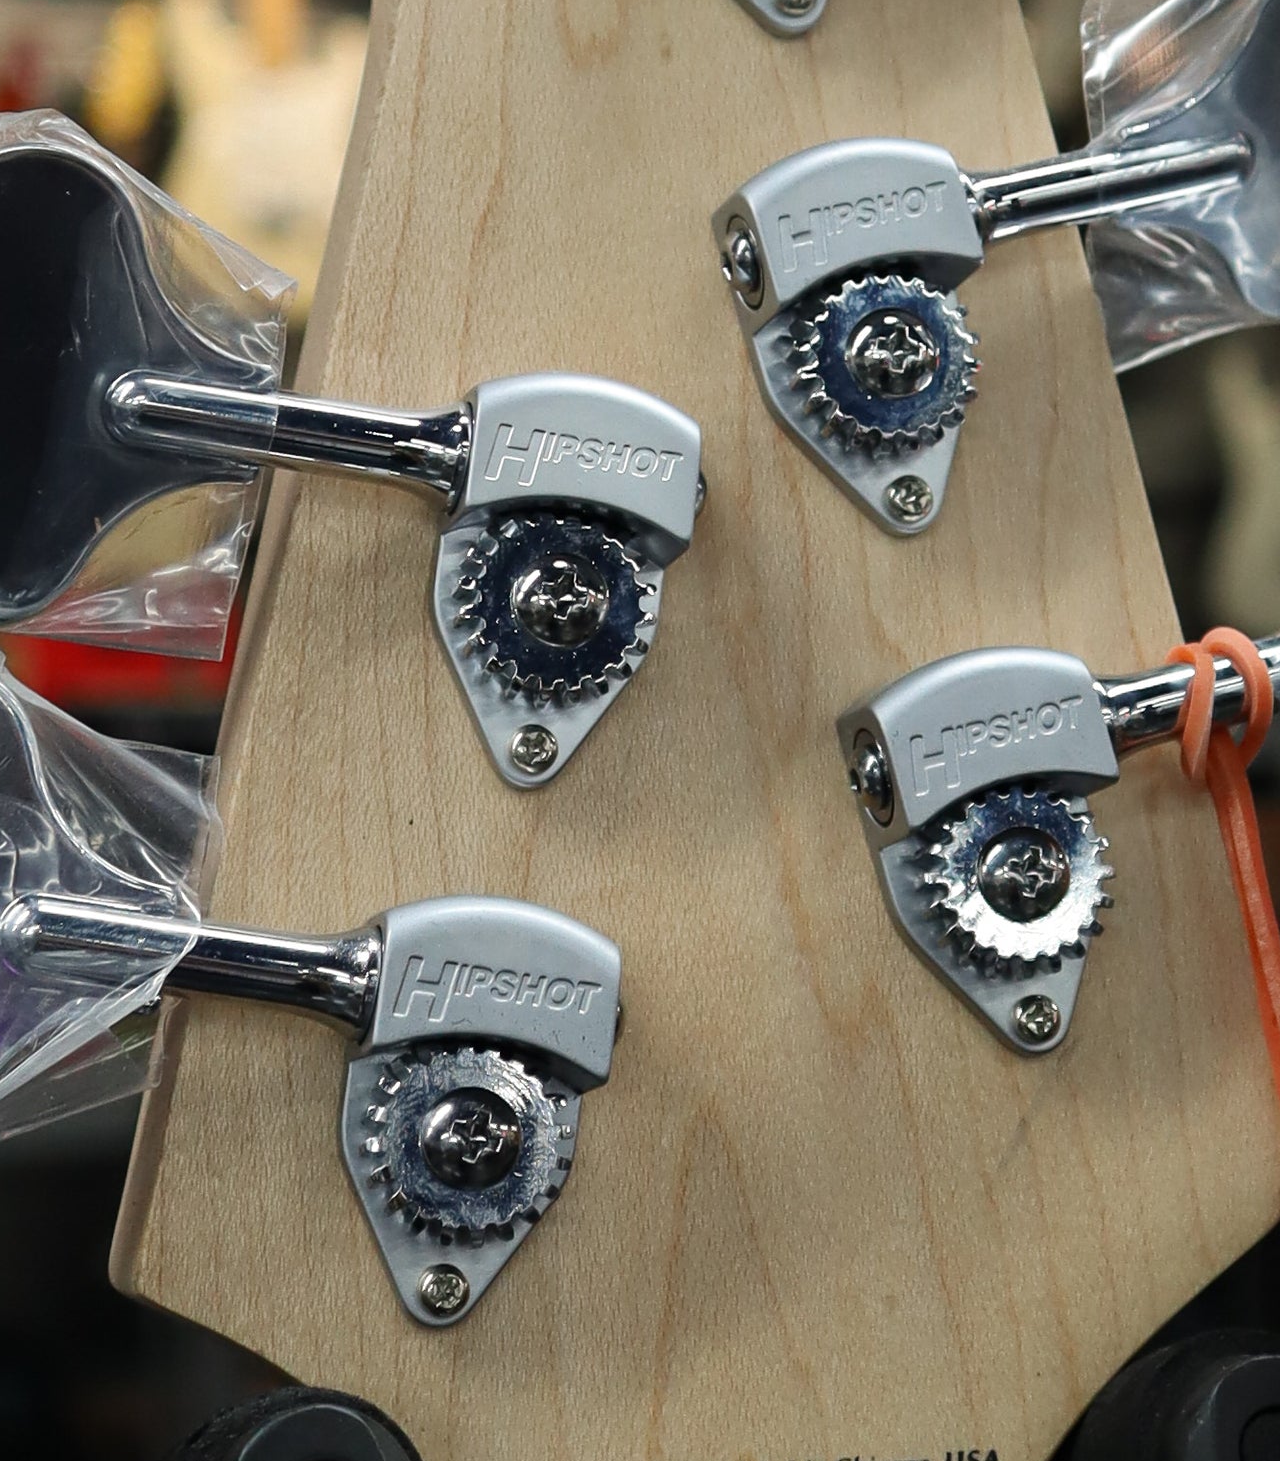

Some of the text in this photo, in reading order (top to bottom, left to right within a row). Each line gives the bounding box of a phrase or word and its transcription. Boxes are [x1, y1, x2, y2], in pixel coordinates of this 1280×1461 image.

[777, 180, 947, 274] HIPSHOT
[483, 422, 685, 488] HIPSHOT
[909, 694, 1084, 798] HIPSHOT
[392, 954, 603, 1024] HIPSHOT
